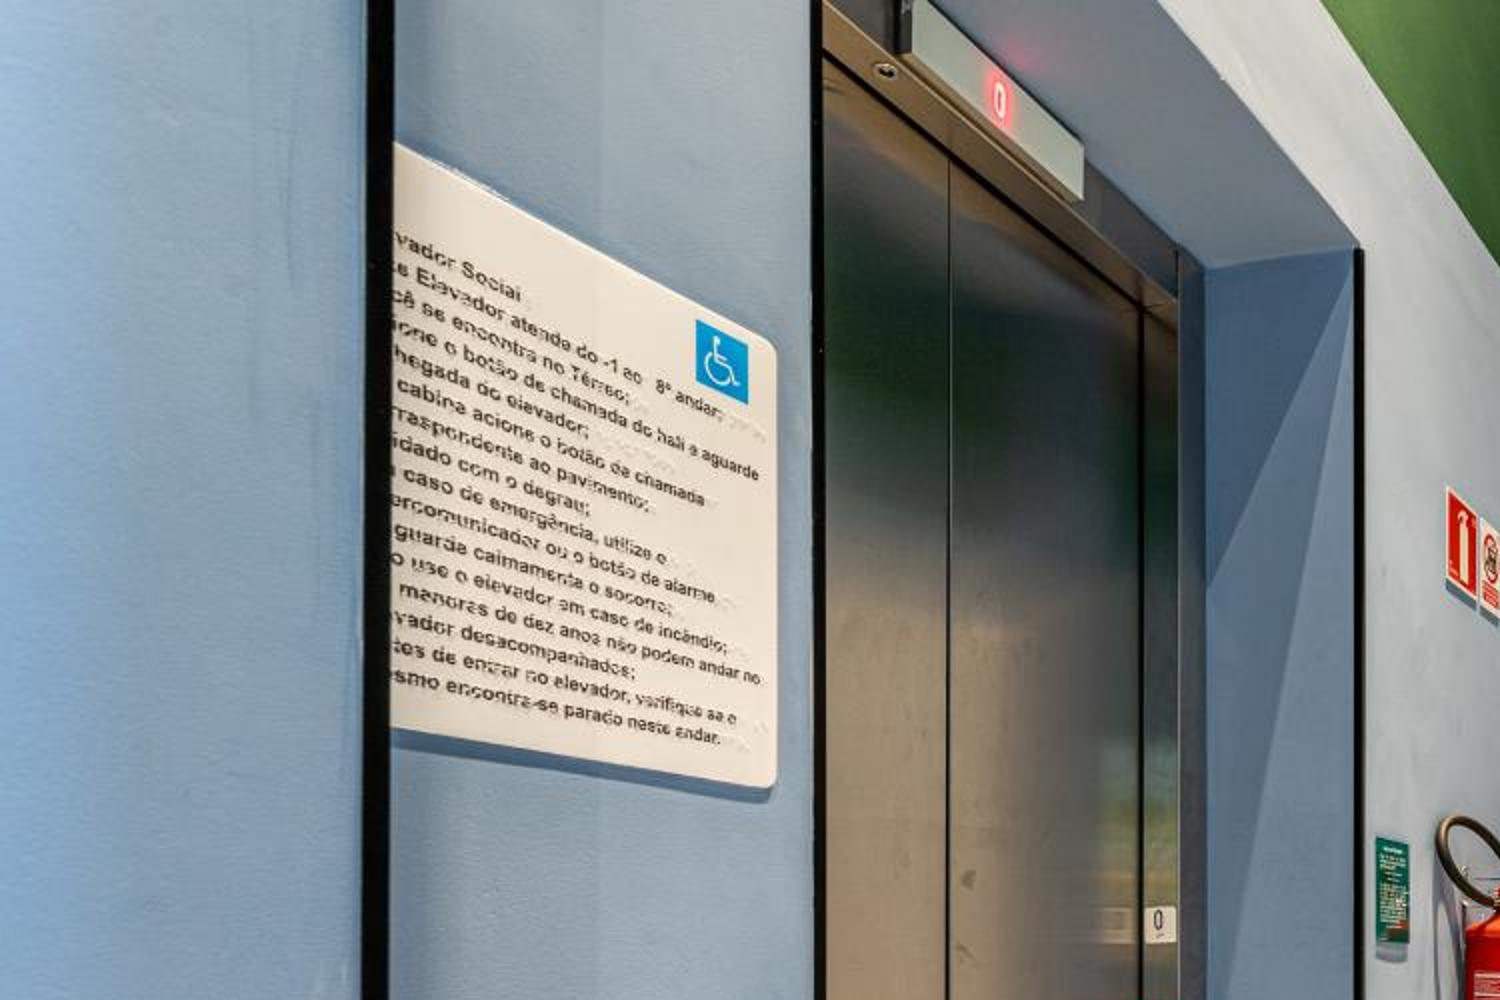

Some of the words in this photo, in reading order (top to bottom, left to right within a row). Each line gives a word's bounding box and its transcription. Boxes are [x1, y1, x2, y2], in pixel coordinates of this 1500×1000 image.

[460, 260, 521, 303] Social
[415, 265, 505, 322] Elevador
[509, 314, 571, 353] atende
[575, 342, 599, 365] do
[622, 366, 643, 385] ao
[421, 301, 446, 323] se
[450, 315, 537, 365] encontra
[541, 354, 565, 377] no
[442, 339, 457, 356] o
[462, 342, 518, 382] botão
[522, 372, 546, 393] de
[549, 384, 628, 429] chamada
[630, 418, 653, 439] do
[656, 425, 685, 452] hall
[687, 443, 699, 457] e
[700, 448, 760, 481] aguarde
[475, 378, 501, 402] do
[456, 458, 499, 484] com
[504, 474, 517, 489] o
[471, 406, 535, 444] acione
[538, 433, 552, 449] o
[555, 436, 606, 470] botão
[608, 458, 631, 479] de
[633, 470, 705, 507] chamada
[528, 456, 551, 477] ao
[402, 468, 454, 496] caso
[458, 484, 484, 506] de
[602, 534, 652, 561] utilize
[654, 552, 668, 566] o
[410, 556, 449, 579] use
[453, 568, 469, 585] o
[472, 572, 554, 608] elevador
[557, 598, 586, 617] em
[589, 606, 629, 629] caso
[632, 616, 654, 635] de
[472, 546, 583, 591] calmamente
[587, 580, 601, 595] o
[544, 541, 568, 560] ou
[572, 550, 584, 565] o
[588, 550, 636, 581] botão
[639, 568, 660, 588] de
[663, 576, 715, 604] alarme
[398, 582, 489, 617] menores
[493, 604, 518, 625] de
[521, 612, 555, 636] dez
[558, 624, 601, 648] anos
[605, 635, 638, 655] não
[640, 644, 695, 669] podem
[697, 658, 740, 679] andar
[741, 670, 761, 686] no
[430, 644, 457, 666] de
[461, 654, 521, 680] entrar
[524, 668, 550, 686] no
[634, 692, 703, 718] verifique
[705, 708, 725, 723] se
[726, 712, 737, 726] o
[444, 679, 559, 715] encontra-se
[563, 703, 624, 727] parado
[627, 716, 671, 736] neste
